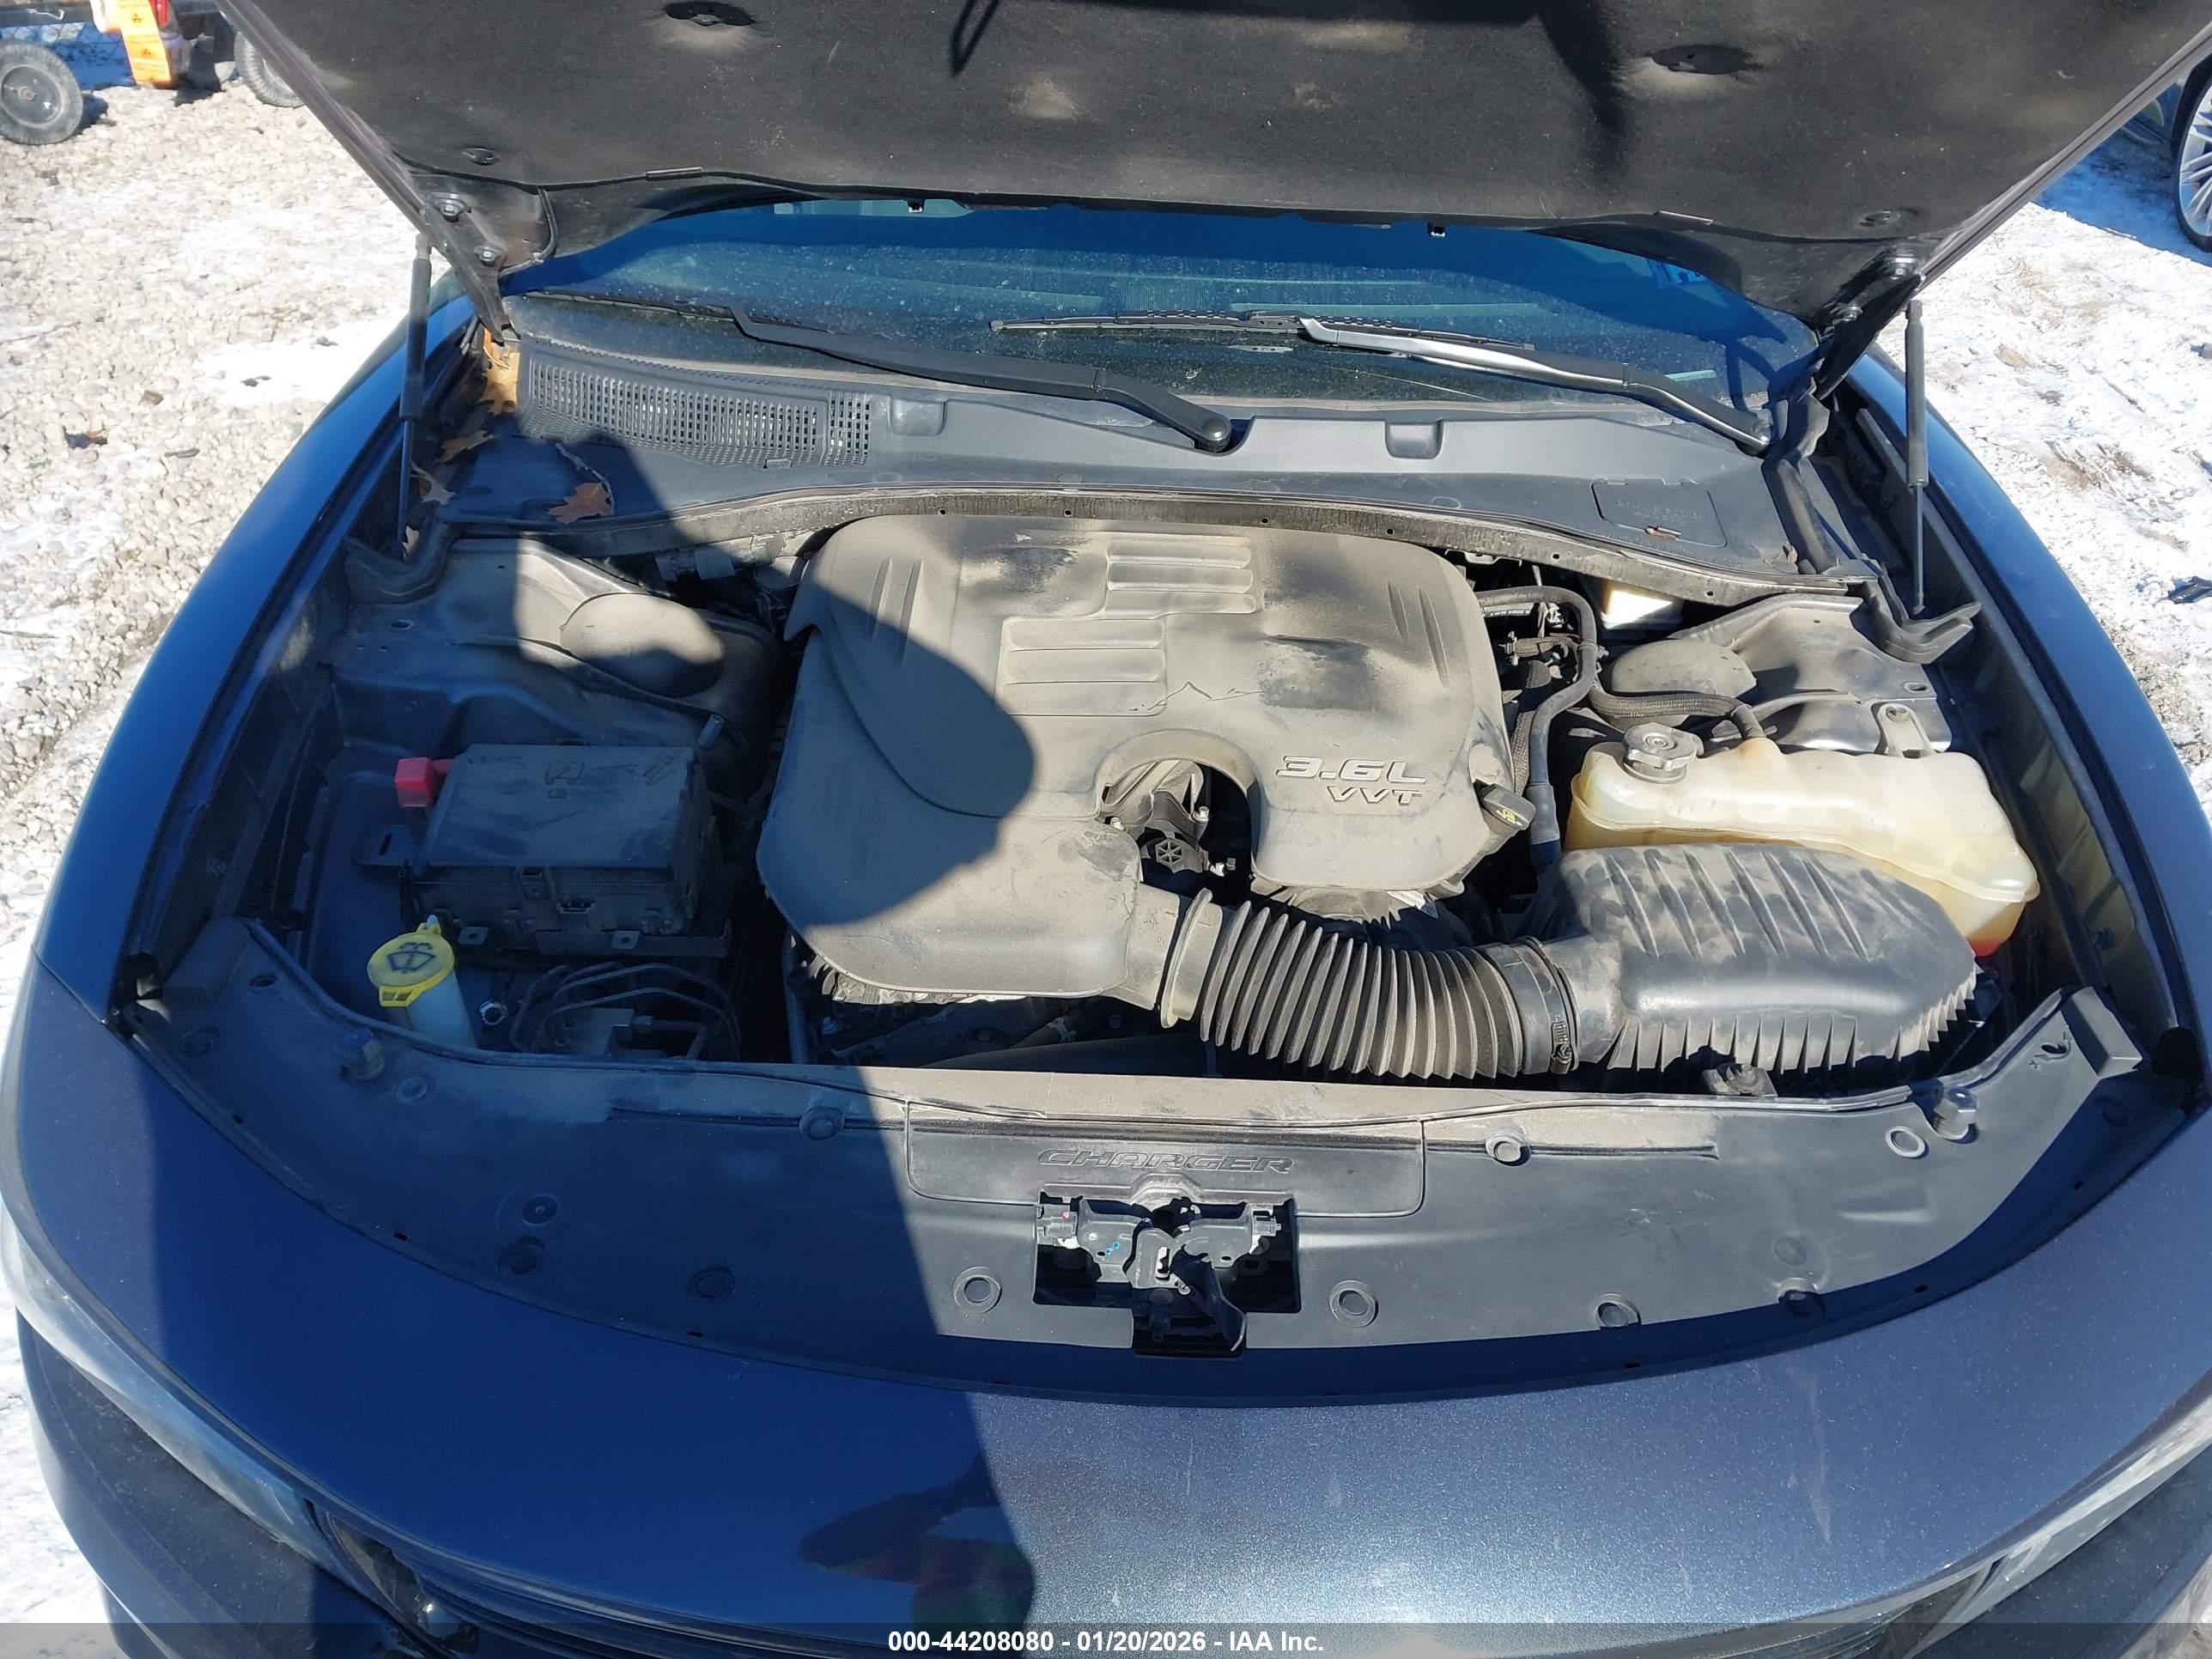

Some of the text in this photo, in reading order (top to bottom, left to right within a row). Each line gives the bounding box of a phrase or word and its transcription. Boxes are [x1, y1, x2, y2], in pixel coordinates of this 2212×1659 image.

[1276, 756, 1426, 783] 3.6L
[1327, 786, 1422, 805] VVT
[1037, 1149, 1294, 1174] CHARGER
